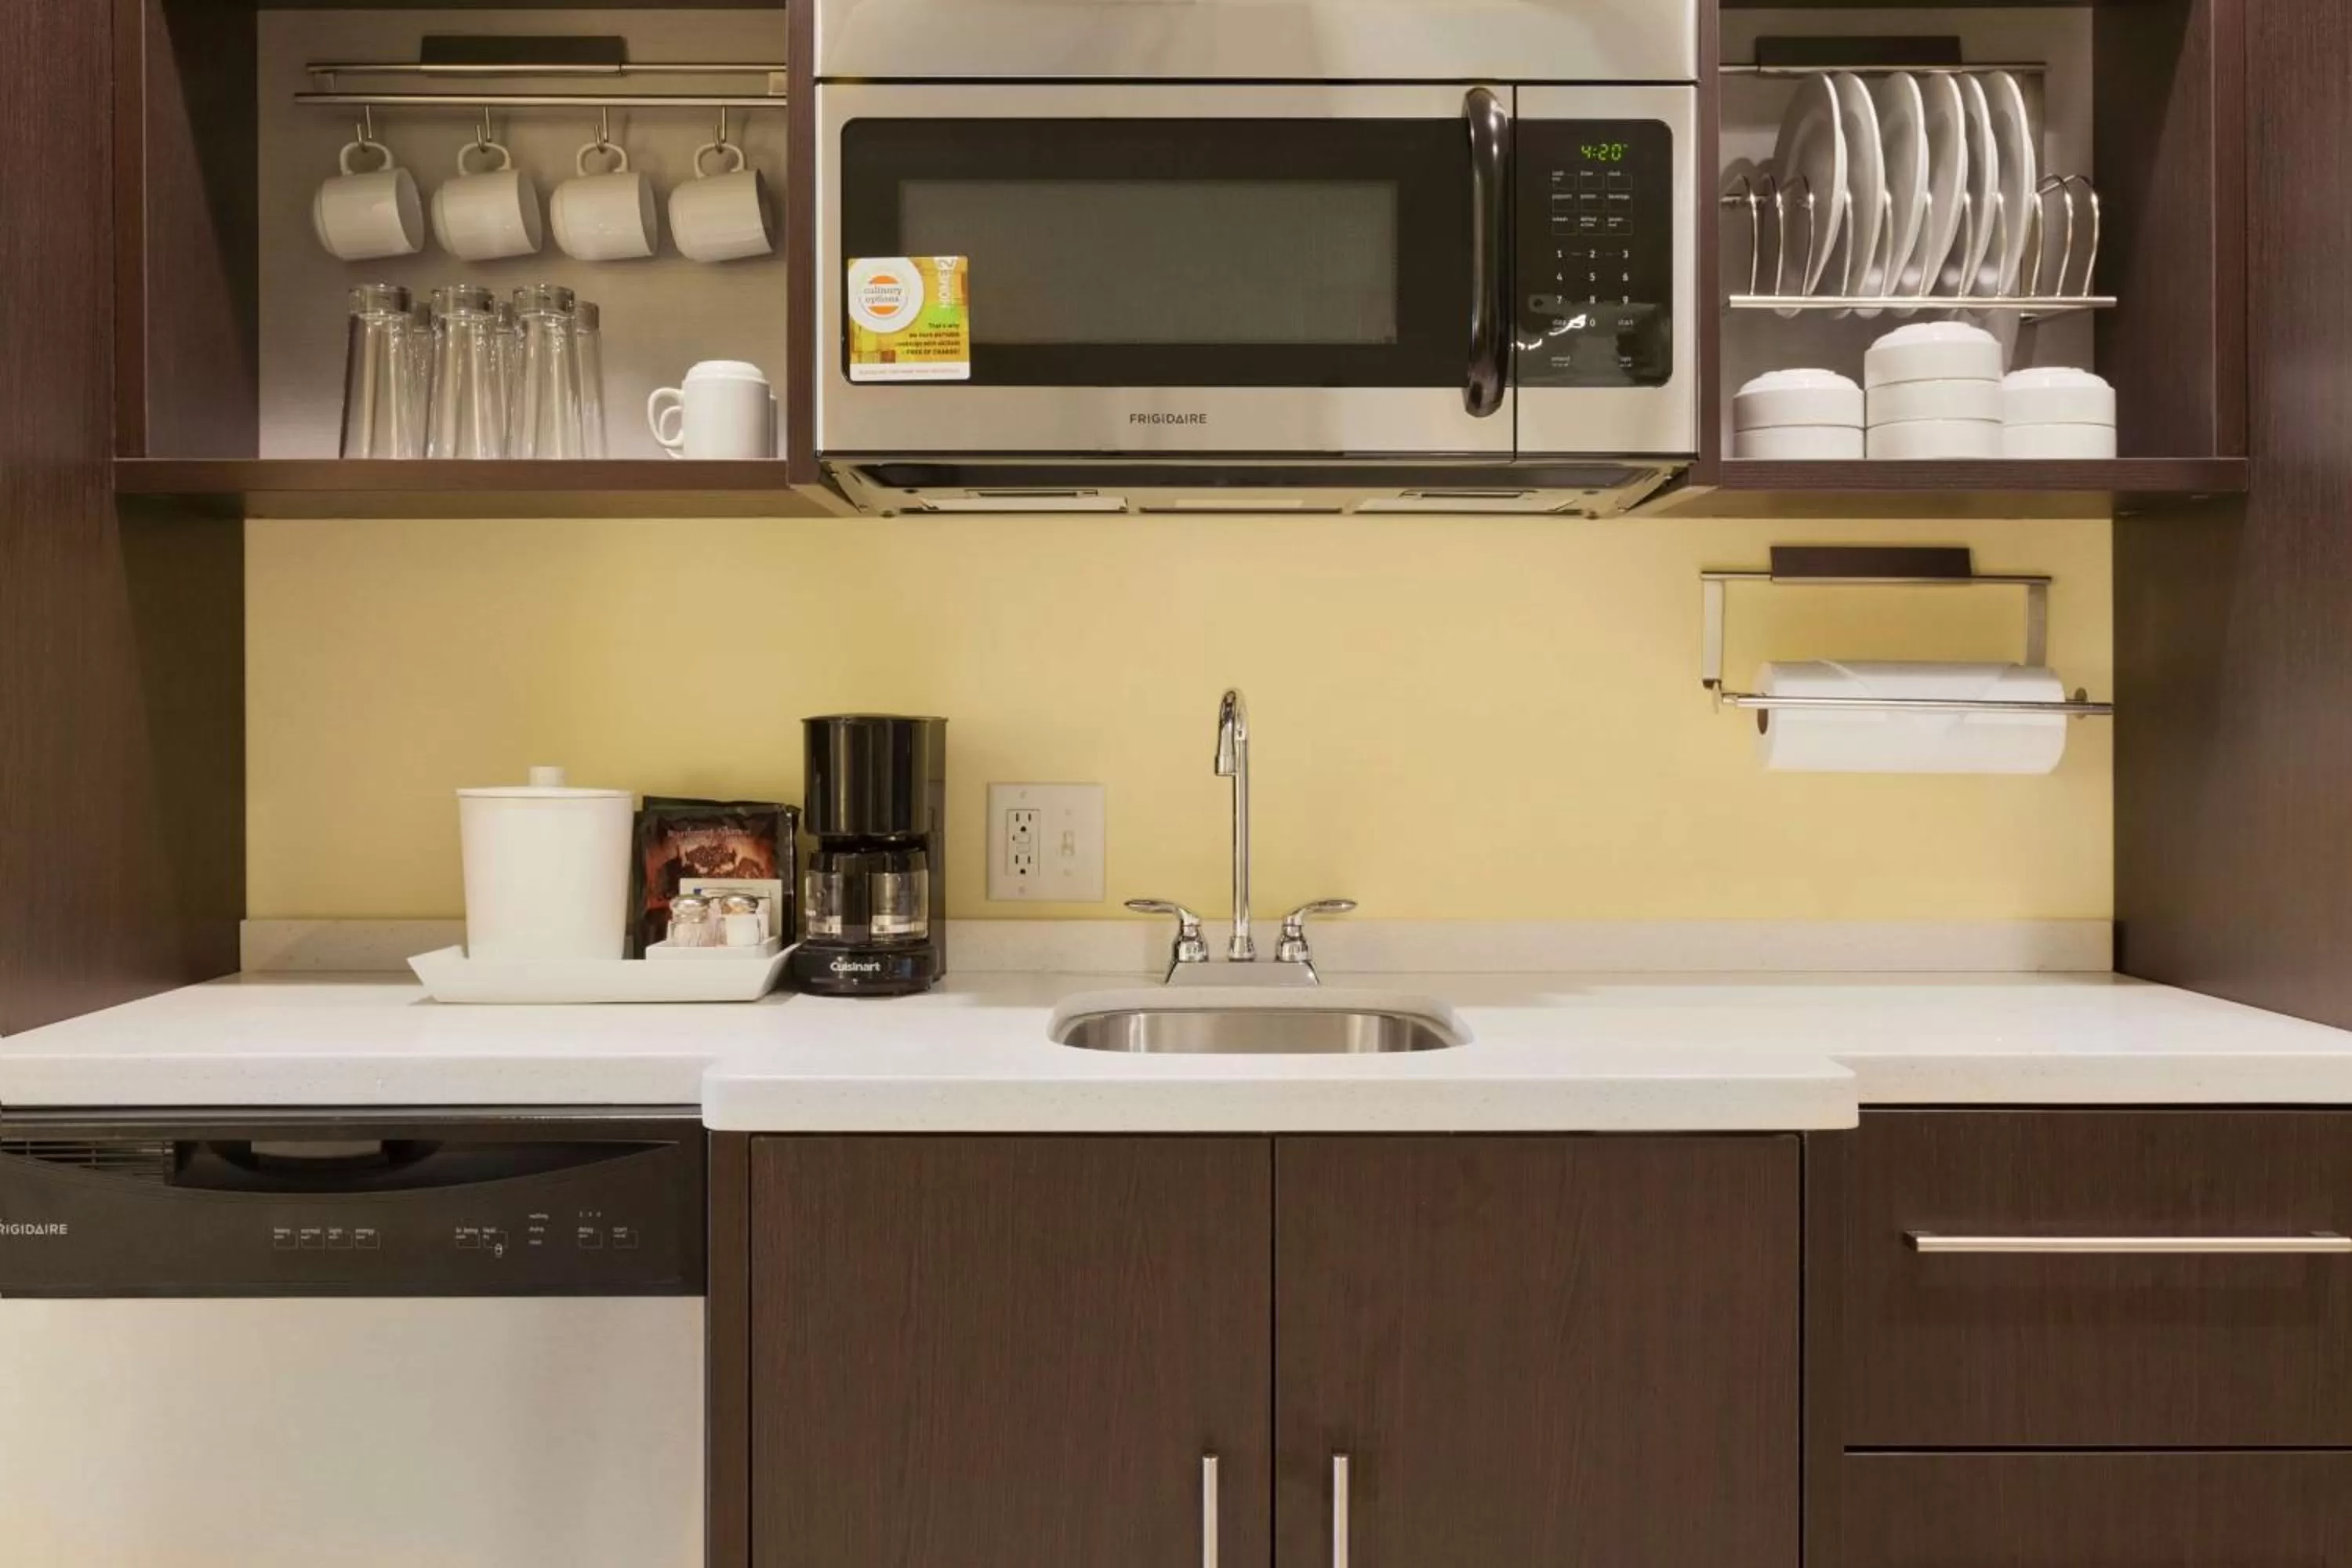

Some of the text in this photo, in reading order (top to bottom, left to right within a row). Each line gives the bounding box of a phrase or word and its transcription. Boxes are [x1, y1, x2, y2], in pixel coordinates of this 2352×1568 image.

[1581, 143, 1622, 161] 4:20
[1590, 273, 1595, 281] 5
[1623, 273, 1628, 281] 6
[863, 285, 902, 295] culinary
[866, 296, 899, 304] options
[1557, 296, 1628, 304] 7 8 9
[1590, 318, 1595, 327] 0
[1129, 413, 1207, 424] FRIGIDAIRE
[830, 962, 881, 971] Cuisinart
[0, 1222, 69, 1236] RIGIDAIRE
